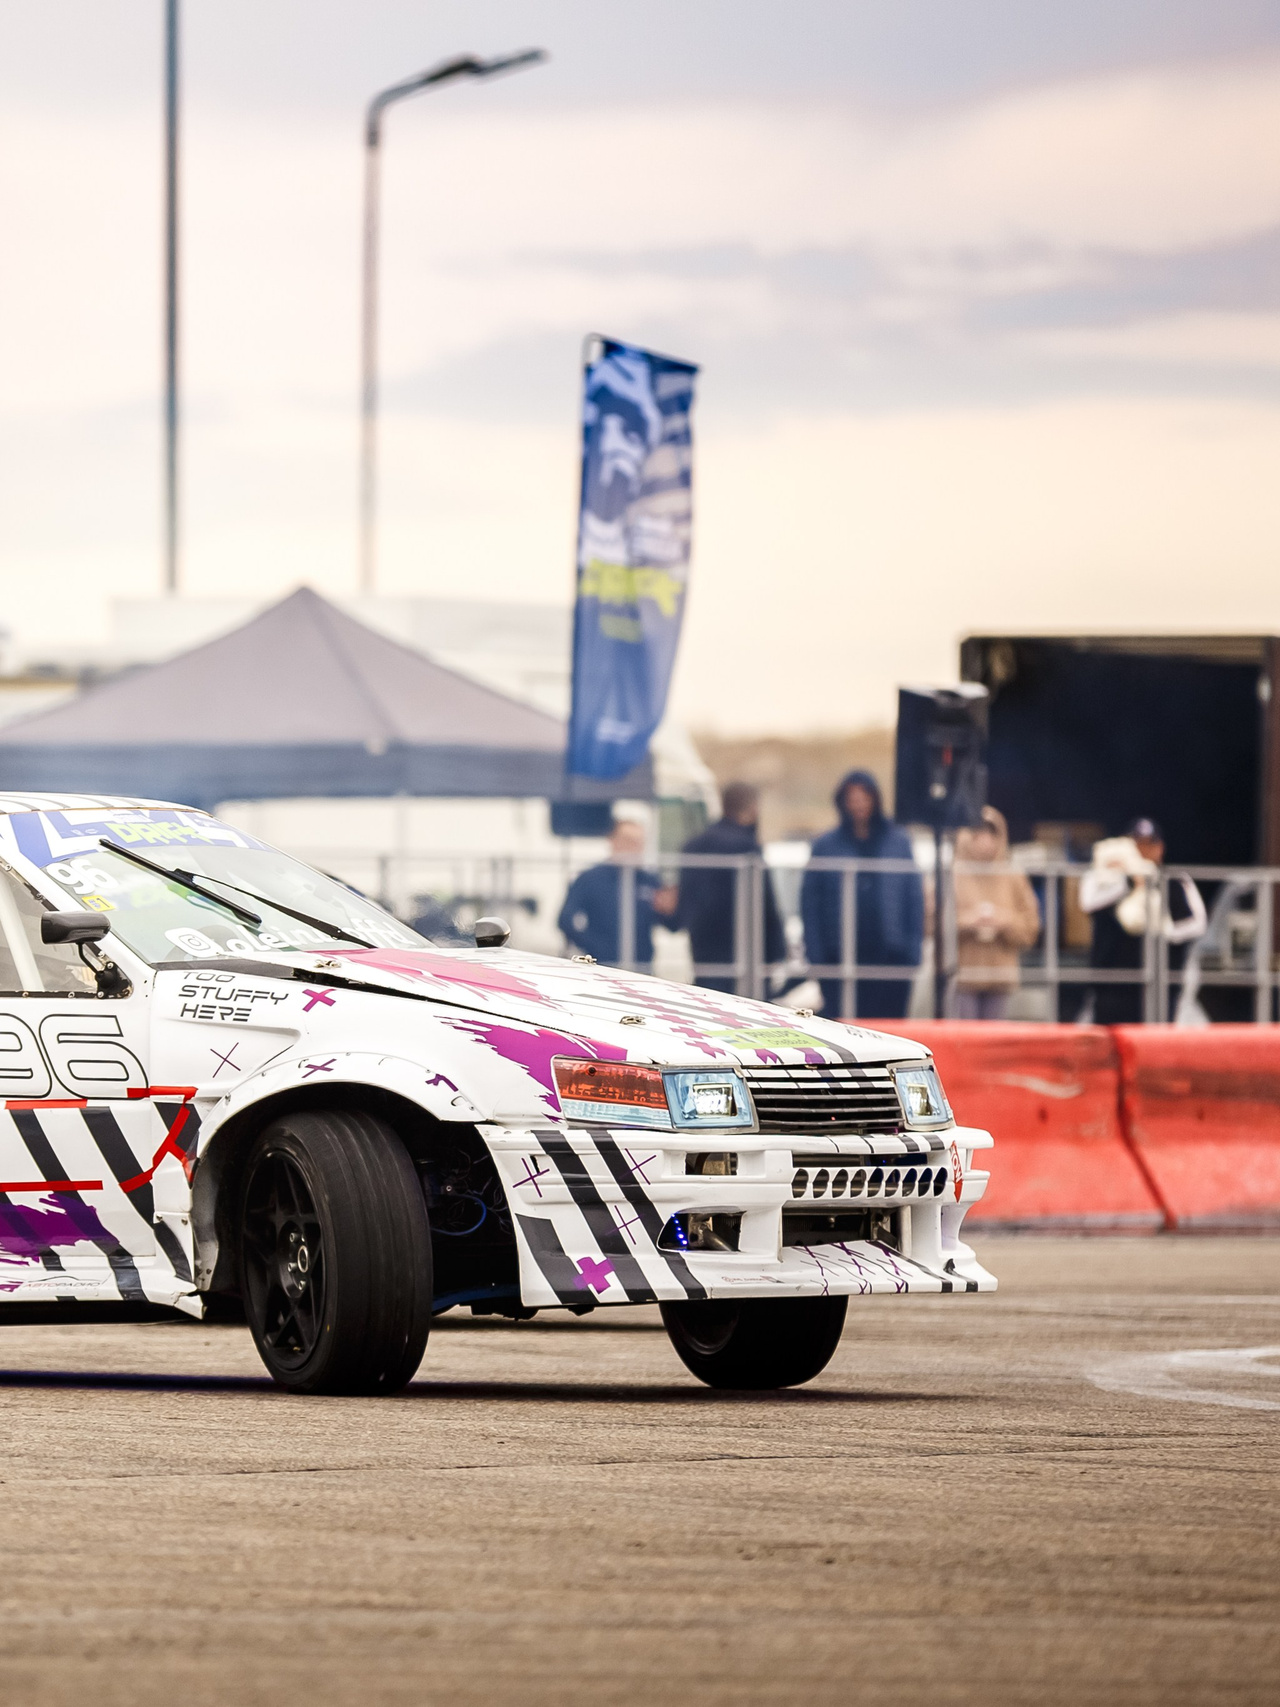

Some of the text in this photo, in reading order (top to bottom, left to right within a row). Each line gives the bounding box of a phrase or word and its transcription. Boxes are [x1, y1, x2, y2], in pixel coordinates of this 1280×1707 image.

[46, 858, 119, 895] 96
[183, 971, 236, 983] TOO
[179, 985, 289, 1005] STUFFY
[180, 1003, 252, 1022] HERE
